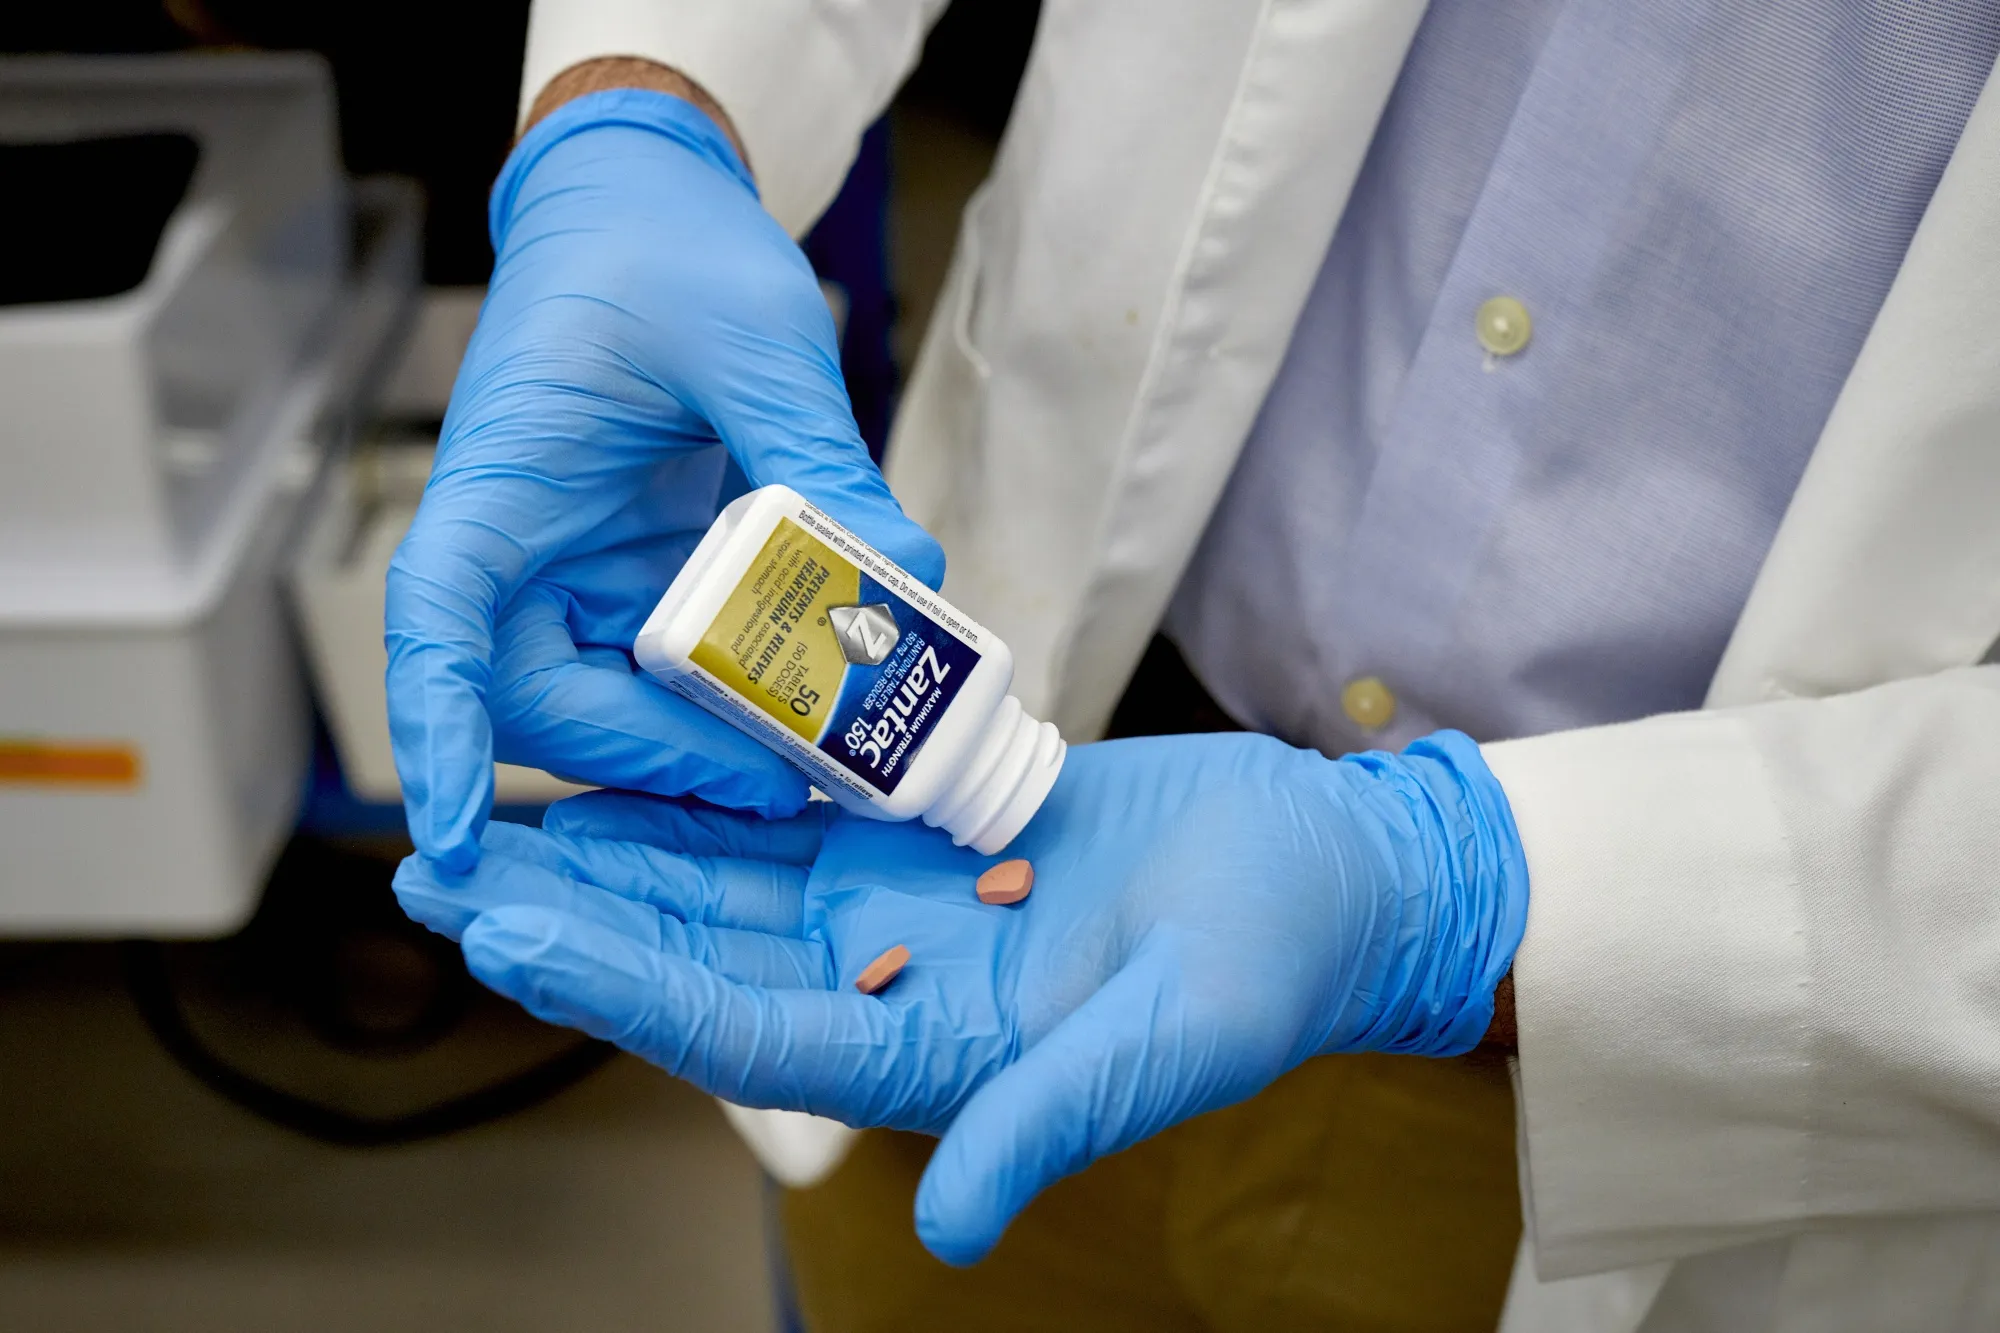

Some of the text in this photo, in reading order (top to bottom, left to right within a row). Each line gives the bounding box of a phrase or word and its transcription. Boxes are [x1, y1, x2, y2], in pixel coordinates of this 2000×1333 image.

[750, 538, 791, 595] sour stomach
[787, 564, 830, 623] PREVENTS
[797, 509, 816, 527] Bottle
[813, 521, 835, 540] sealed
[831, 534, 846, 548] with
[842, 543, 865, 562] printed
[862, 555, 874, 568] foil
[871, 563, 890, 579] under
[886, 574, 900, 588] cap.
[898, 581, 909, 593] Do
[906, 587, 919, 600] not
[915, 594, 928, 607] use
[930, 604, 942, 616] foil
[939, 610, 948, 621] is
[944, 615, 961, 631] open
[958, 624, 967, 635] or
[964, 628, 979, 644] torn.
[729, 547, 804, 655] with acid indigestion and
[737, 556, 818, 671] HEARTBURN associated
[779, 620, 793, 634] &
[746, 632, 785, 685] RELIEVES
[845, 610, 887, 659] Z
[895, 641, 908, 656] mg
[904, 630, 917, 645] 150
[765, 640, 808, 697] (50 DOSES)
[777, 664, 809, 704] TABLETS
[861, 675, 887, 710] REDUCER
[874, 637, 925, 710] RANITIDINE TABLETS
[882, 657, 899, 678] ACID
[789, 683, 820, 716] 50
[859, 644, 951, 768] Zantac
[689, 669, 724, 694] Directions
[727, 696, 748, 712] adults
[746, 709, 762, 721] and
[759, 718, 785, 738] children
[784, 734, 795, 743] 12
[792, 741, 811, 755] years
[810, 753, 824, 764] and
[843, 775, 852, 783] to
[850, 780, 874, 798] relieve
[880, 686, 942, 777] MAXIMUM STRENGTH
